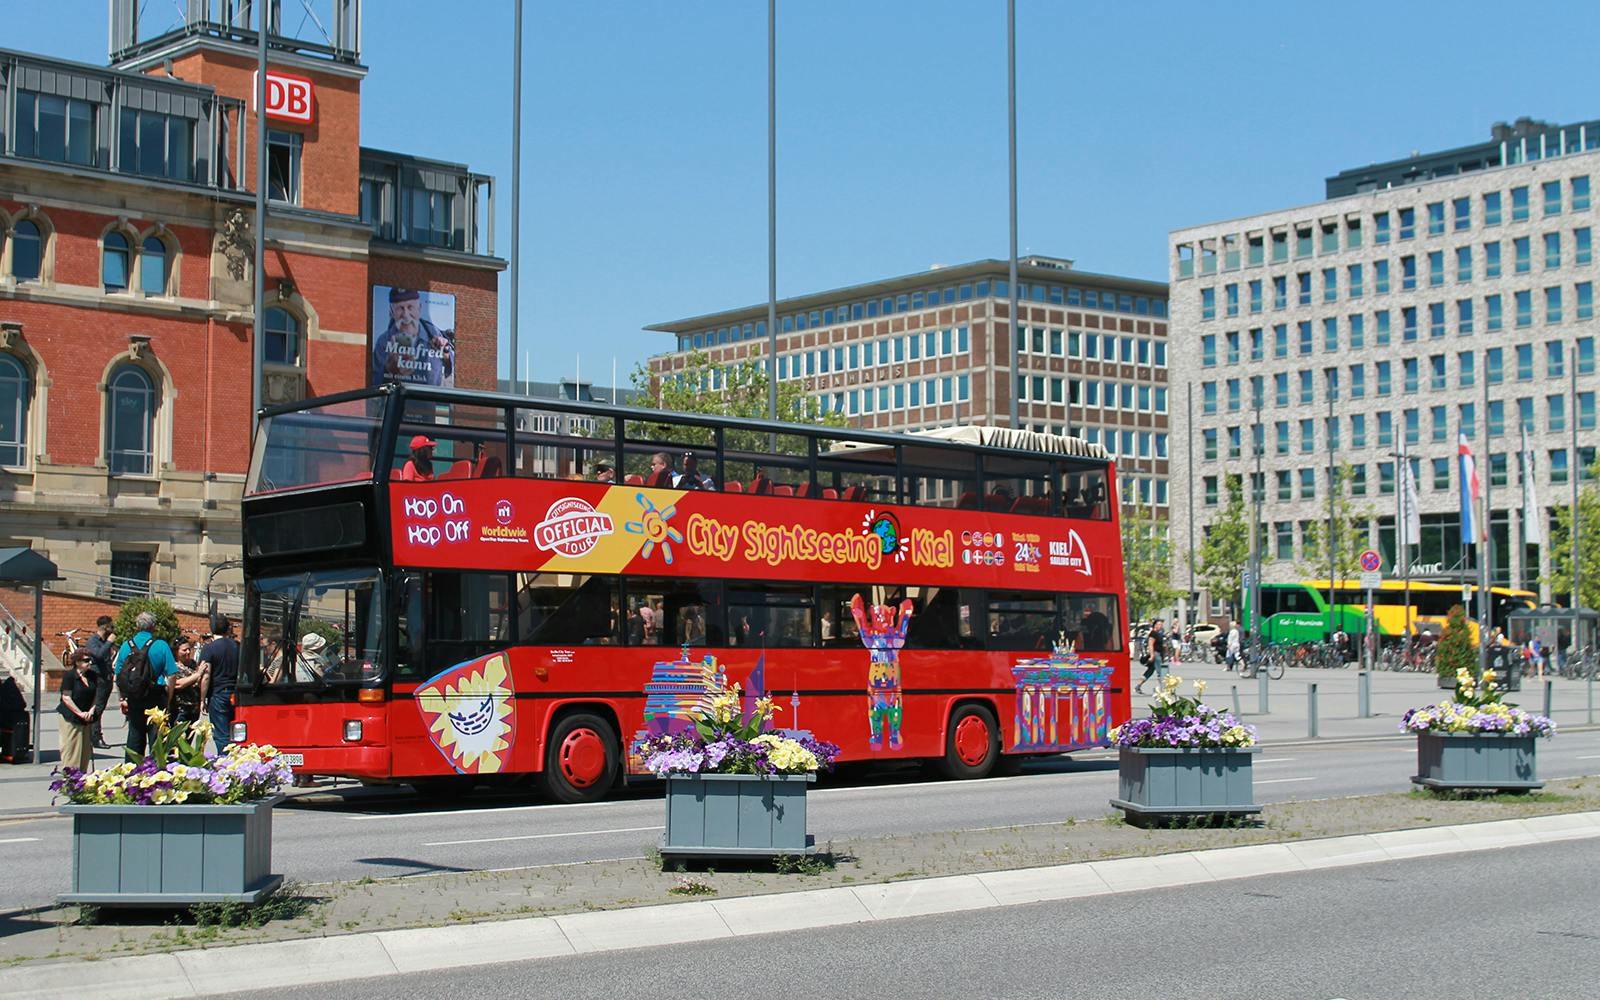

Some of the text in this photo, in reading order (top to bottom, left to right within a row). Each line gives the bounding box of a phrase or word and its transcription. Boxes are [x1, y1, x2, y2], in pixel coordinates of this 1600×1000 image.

[266, 79, 307, 114] DB
[385, 341, 444, 359] Manfred
[397, 356, 432, 371] kann
[404, 493, 464, 519] Hop On
[408, 520, 469, 546] Hop Off
[543, 517, 609, 544] OFFICIAL
[565, 537, 594, 554] TOUR
[687, 513, 954, 570] City Sightseeing Kiel
[1049, 541, 1070, 556] KIEL
[1015, 542, 1029, 562] 24
[1070, 557, 1082, 567] CITY
[1391, 562, 1443, 577] AANTIC
